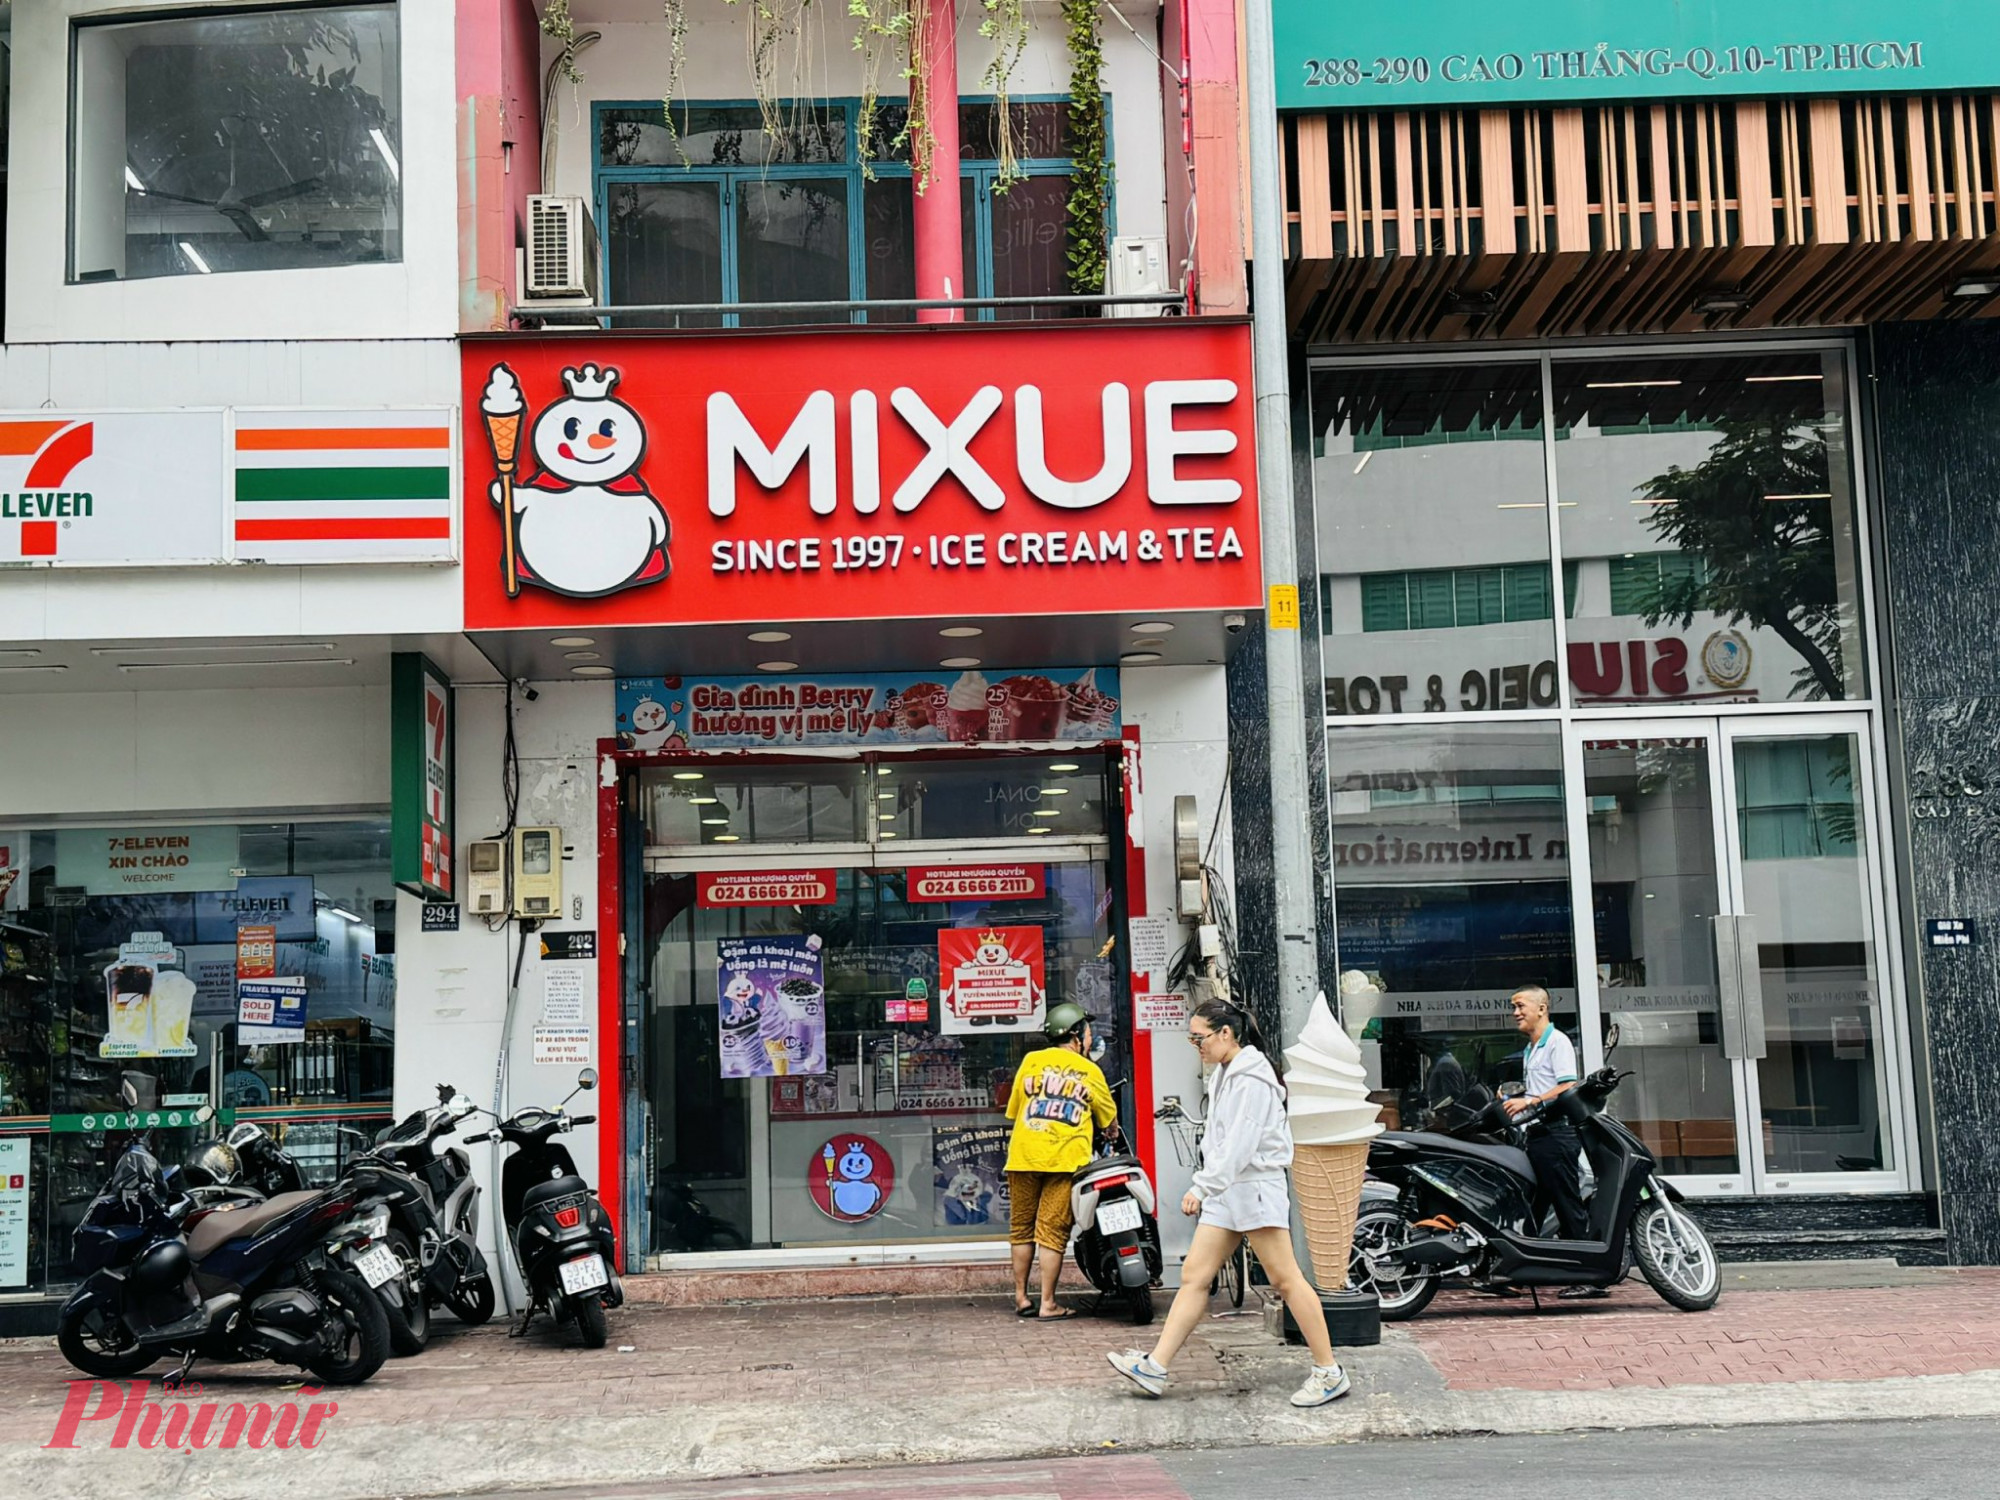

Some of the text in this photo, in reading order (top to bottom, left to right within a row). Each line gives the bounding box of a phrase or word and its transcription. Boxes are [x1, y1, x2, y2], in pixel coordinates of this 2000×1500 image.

[1304, 57, 1430, 87] 288-290
[1440, 53, 1524, 82] CAO
[706, 379, 1242, 517] MIXUE
[0, 492, 93, 517] LEVEn
[711, 526, 1243, 572] SINCE 1997 ICE CREAM & TEA
[1277, 600, 1291, 613] 11
[692, 683, 875, 711] Gia đình Berry
[692, 711, 777, 740] hương
[780, 707, 803, 740] vị
[808, 706, 847, 732] mê
[850, 707, 875, 737] ly
[108, 836, 190, 851] 7-ELEVEN
[108, 852, 190, 869] XIN CHÀO
[122, 873, 176, 883] WELCOME
[716, 876, 751, 884] HOTLINE
[926, 871, 960, 879] HOTLINE
[715, 884, 818, 899] 024 6666 2111
[925, 879, 1028, 894] 024 6666 2111
[425, 907, 456, 922] 294
[764, 946, 794, 957] khoai
[241, 985, 307, 995] TRAVEL SIM CARD
[242, 1001, 272, 1010] SOLD
[243, 1012, 271, 1021] HERE
[901, 1097, 987, 1108] 024 6666 2111
[974, 1127, 1004, 1140] khoai
